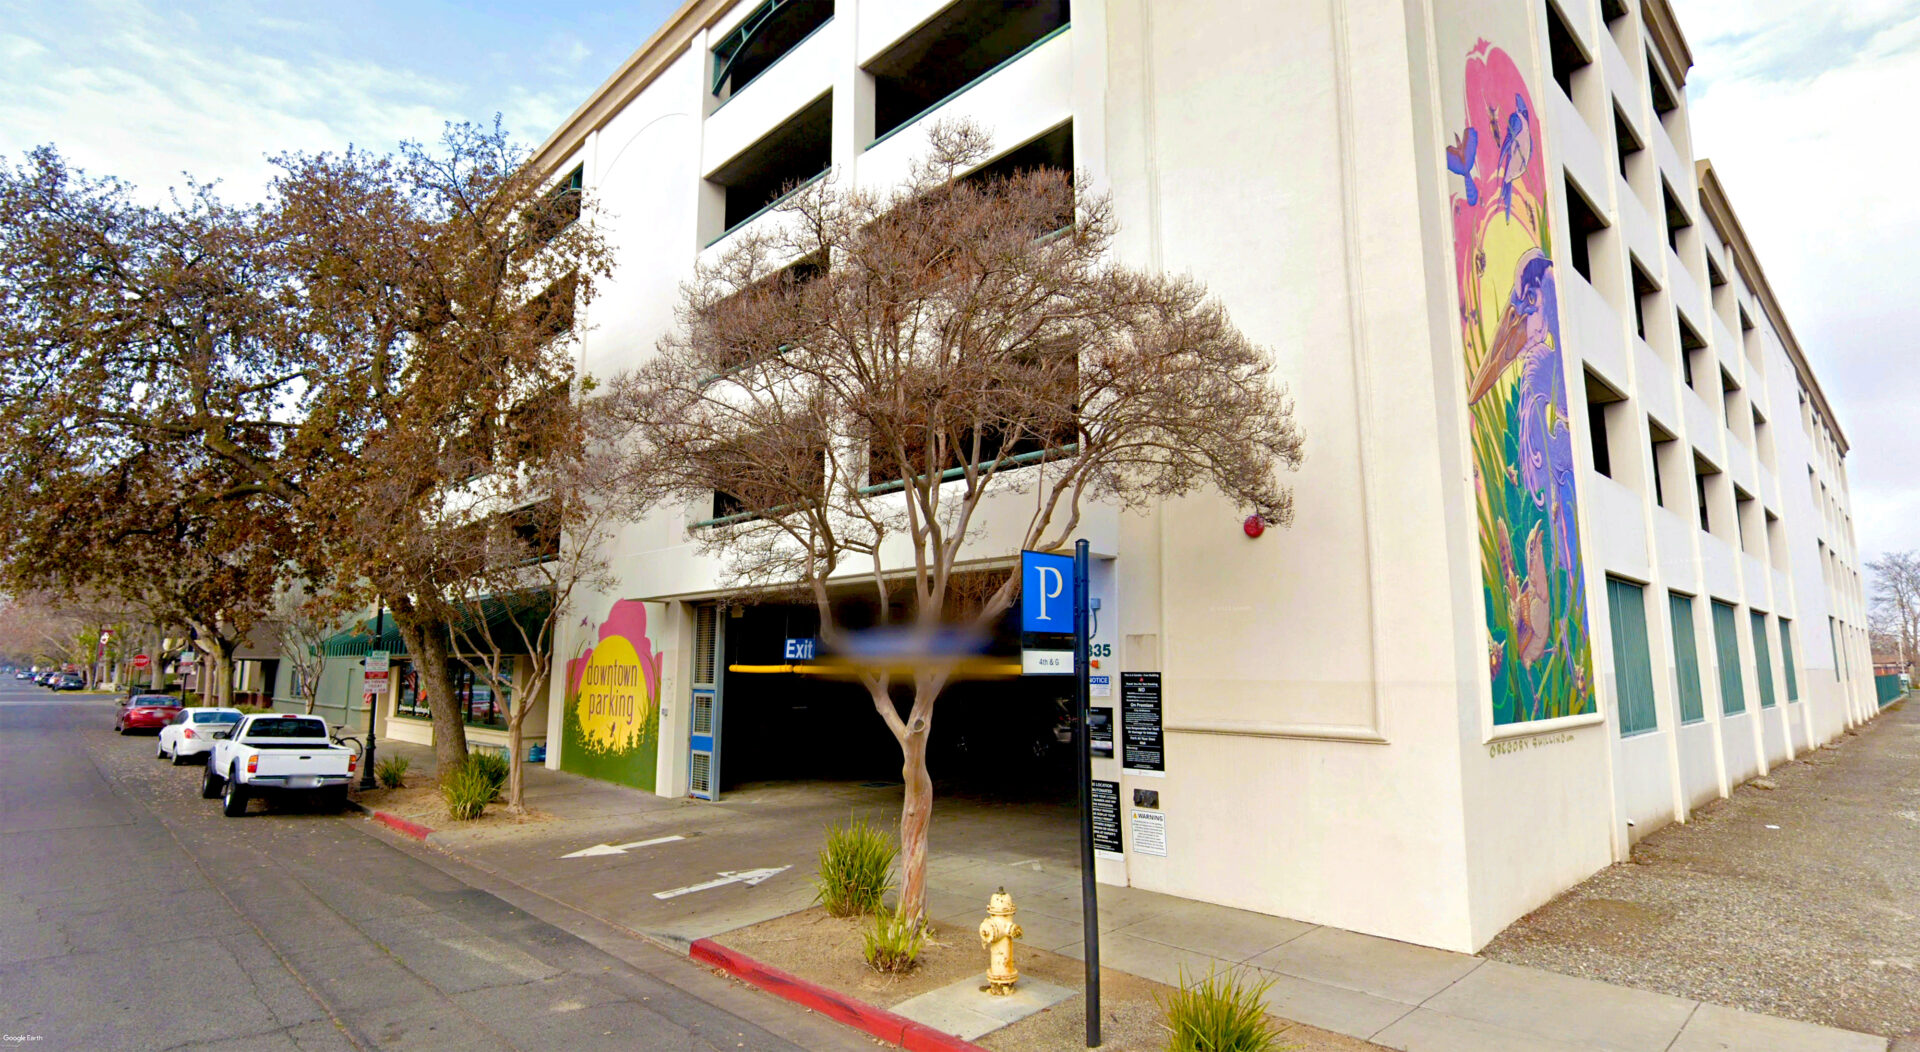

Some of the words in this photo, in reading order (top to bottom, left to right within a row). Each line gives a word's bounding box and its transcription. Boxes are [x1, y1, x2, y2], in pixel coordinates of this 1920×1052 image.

[1033, 566, 1063, 620] P
[785, 639, 813, 659] Exit
[587, 656, 638, 687] downtown
[1039, 658, 1049, 666] 4th
[1049, 658, 1055, 666] &
[1055, 658, 1060, 666] G
[588, 683, 634, 725] parking
[1138, 813, 1164, 822] WARNING
